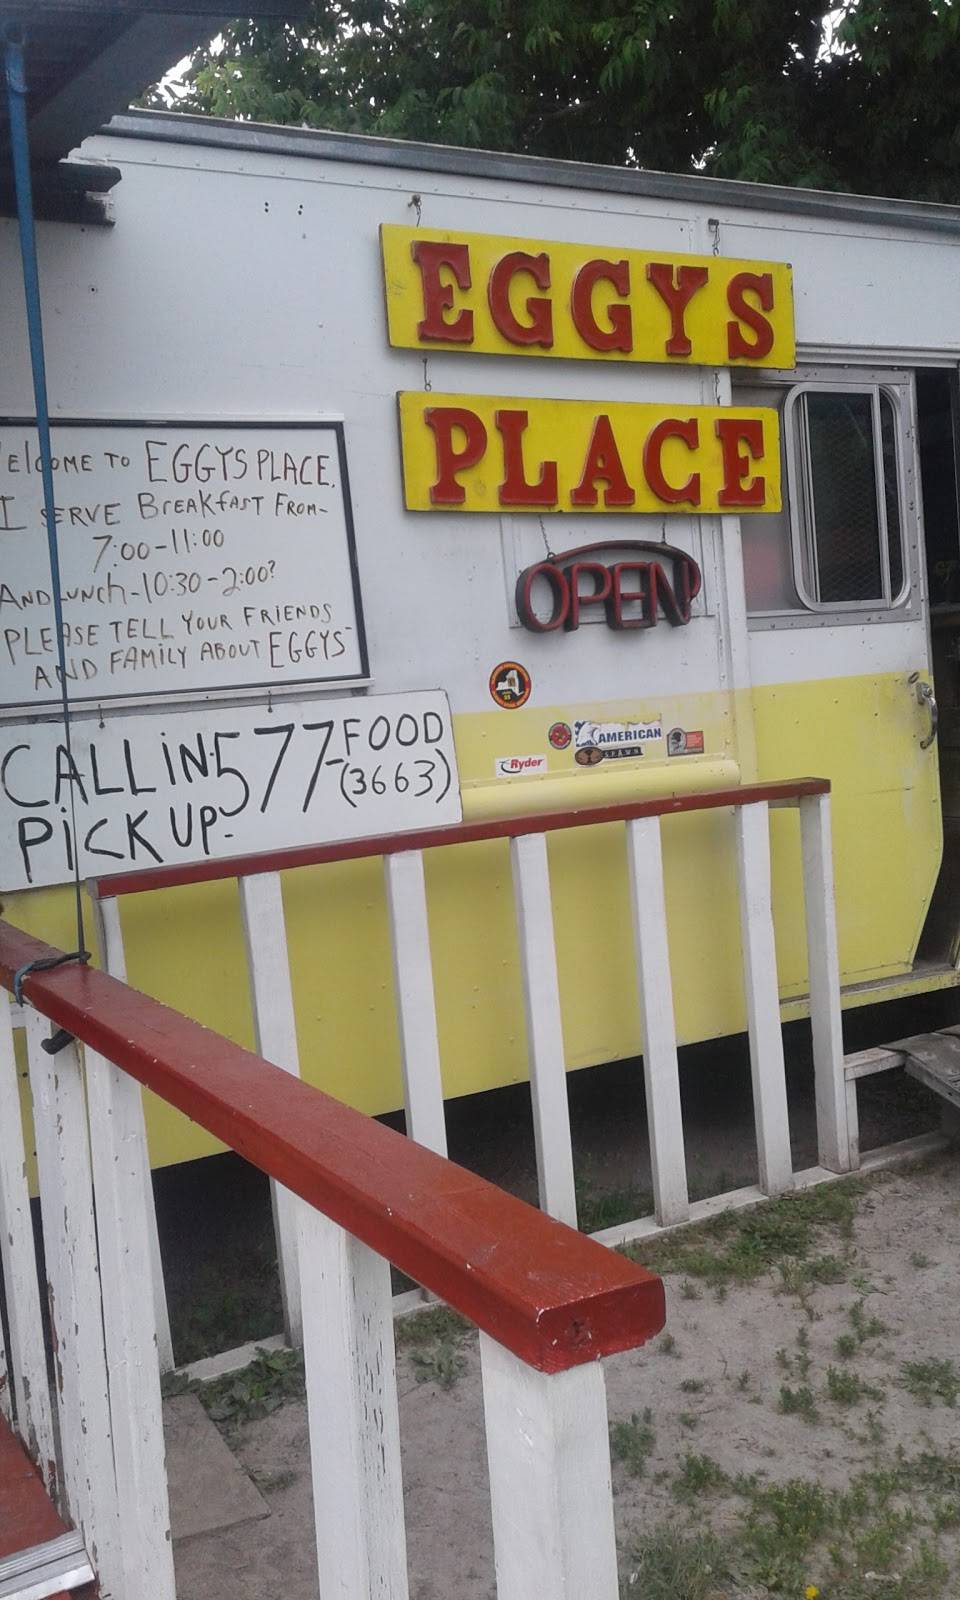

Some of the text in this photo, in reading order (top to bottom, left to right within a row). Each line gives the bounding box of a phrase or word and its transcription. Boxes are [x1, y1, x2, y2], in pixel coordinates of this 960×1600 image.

[411, 240, 774, 360] EGGYS
[104, 452, 130, 468] TO
[145, 441, 247, 482] EGGYS
[425, 407, 766, 506] PLACE
[40, 503, 121, 527] SERVE
[0, 583, 51, 612] AND
[516, 557, 697, 632] OPEN
[4, 621, 100, 666] PLEASE
[109, 617, 174, 643] TELL
[182, 610, 232, 634] YOUR
[35, 658, 98, 691] AND
[200, 640, 261, 662] ABOUT
[343, 712, 444, 756] FOOD
[599, 728, 662, 744] AMERICAN
[510, 757, 545, 772] Ryder
